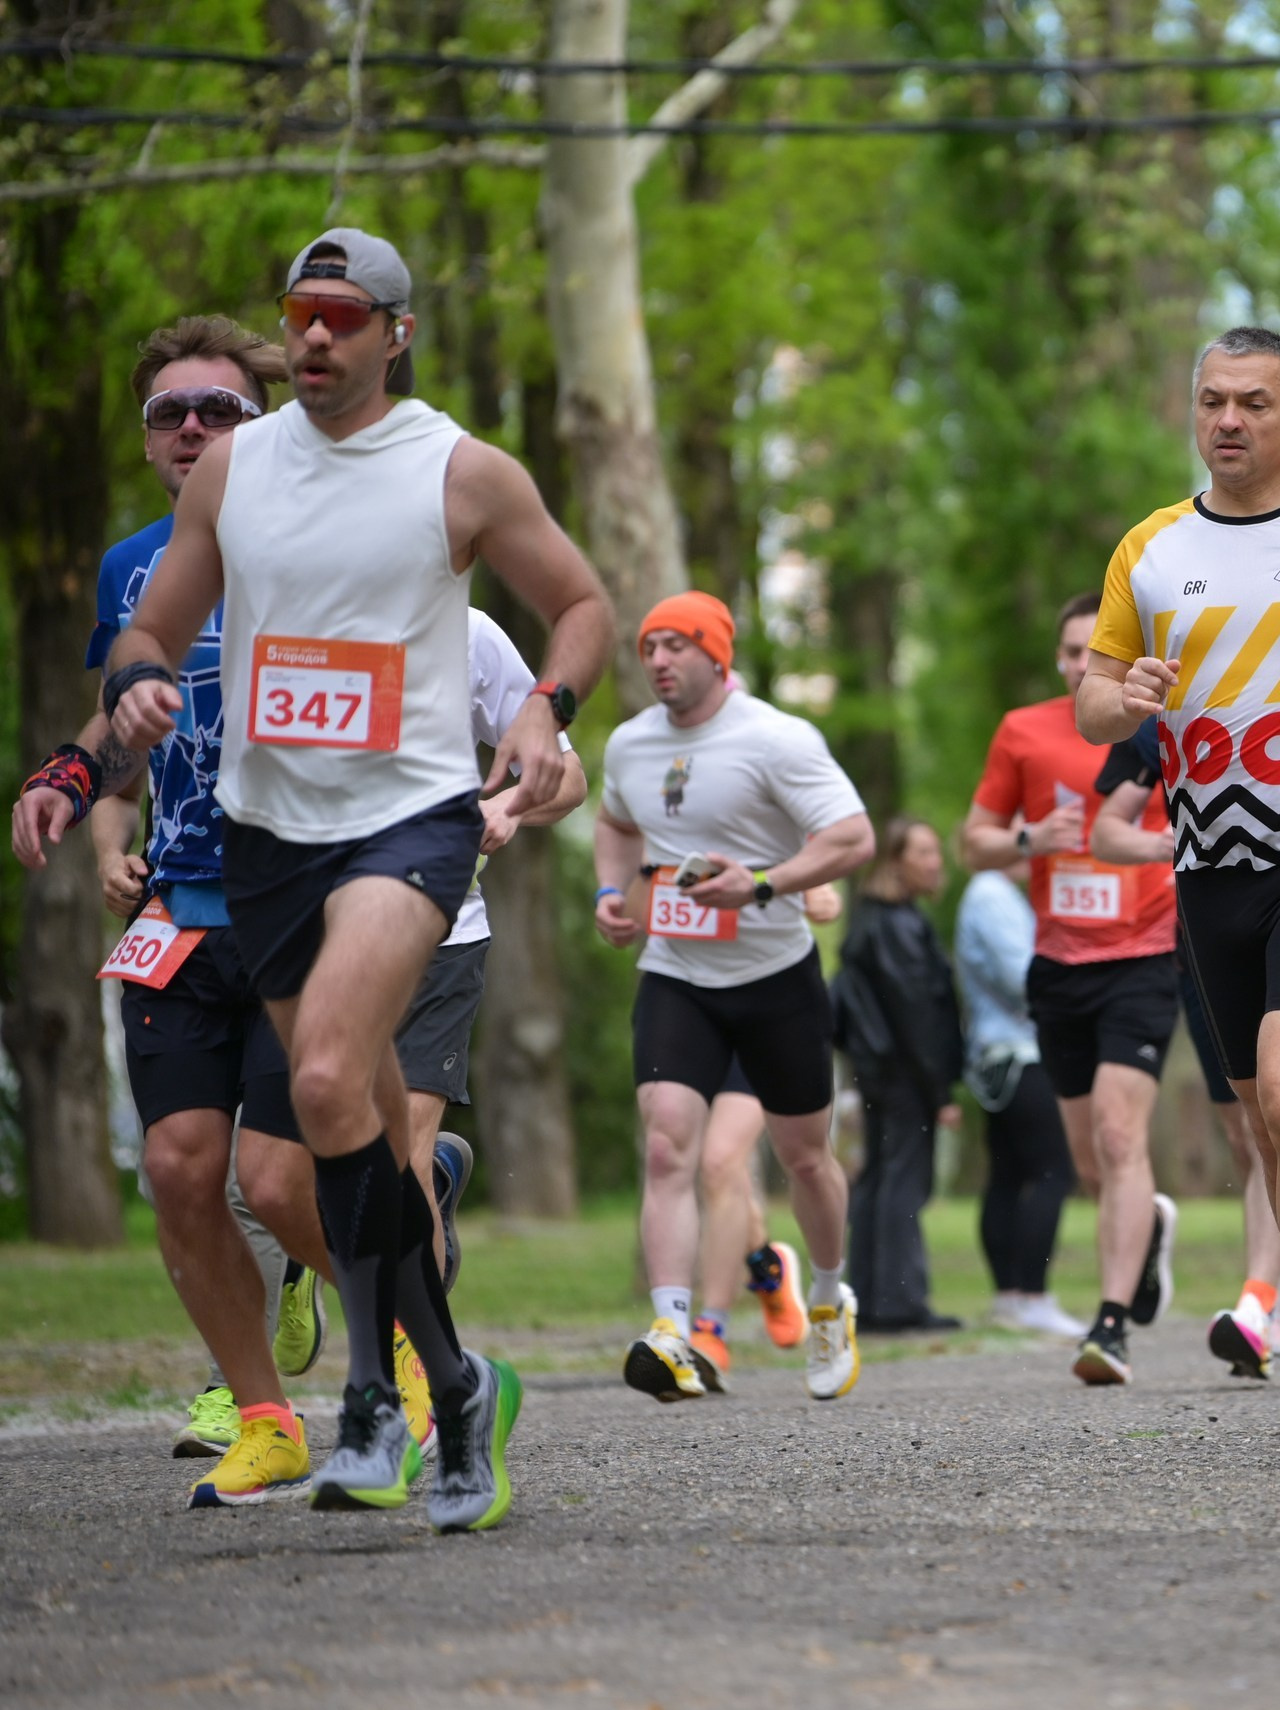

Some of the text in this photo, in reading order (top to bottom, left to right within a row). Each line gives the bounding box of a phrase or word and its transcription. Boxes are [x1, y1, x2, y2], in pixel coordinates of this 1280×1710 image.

[1183, 580, 1208, 596] GRi
[264, 688, 363, 732] 347
[1058, 886, 1111, 912] 351
[657, 901, 712, 929] 357
[108, 935, 162, 969] 350
